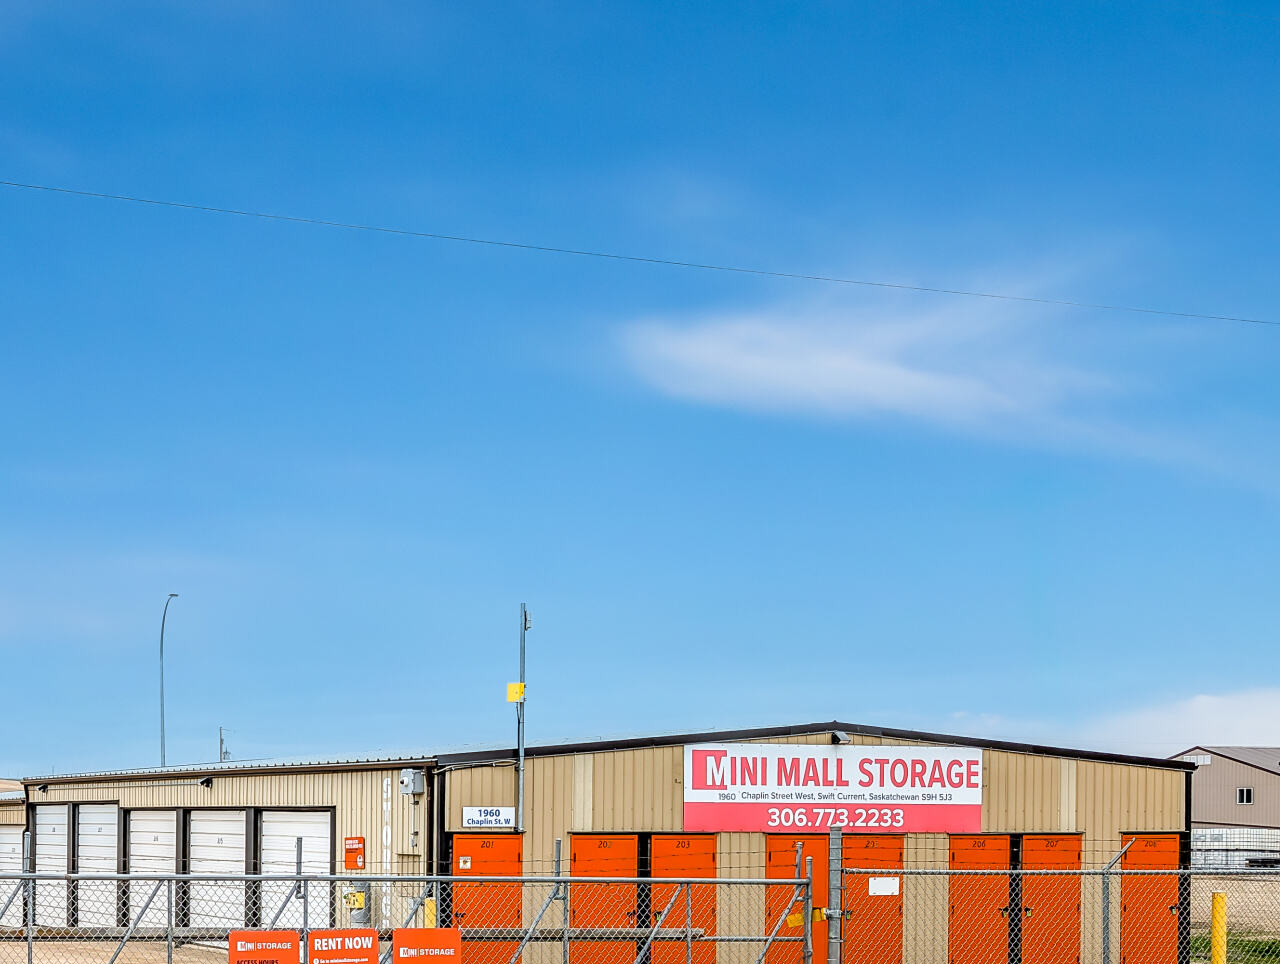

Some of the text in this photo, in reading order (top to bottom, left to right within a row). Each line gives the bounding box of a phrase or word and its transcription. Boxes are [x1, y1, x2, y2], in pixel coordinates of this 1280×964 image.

[706, 755, 979, 788] MINI MALL STORAGE
[741, 791, 769, 800] Chaplin
[771, 792, 794, 800] Street
[795, 792, 816, 800] West,
[817, 792, 835, 800] Swift
[837, 792, 867, 801] Current,
[869, 793, 920, 801] Saskatchewan
[921, 793, 937, 801] S9H
[939, 793, 953, 801] 5J3
[478, 809, 501, 817] 1960
[767, 808, 904, 827] 306.773.2233
[467, 818, 493, 826] Chaplin
[676, 840, 690, 849] 203
[237, 941, 255, 951] MINI
[314, 936, 373, 950] RENT NOW
[400, 947, 418, 957] MINI
